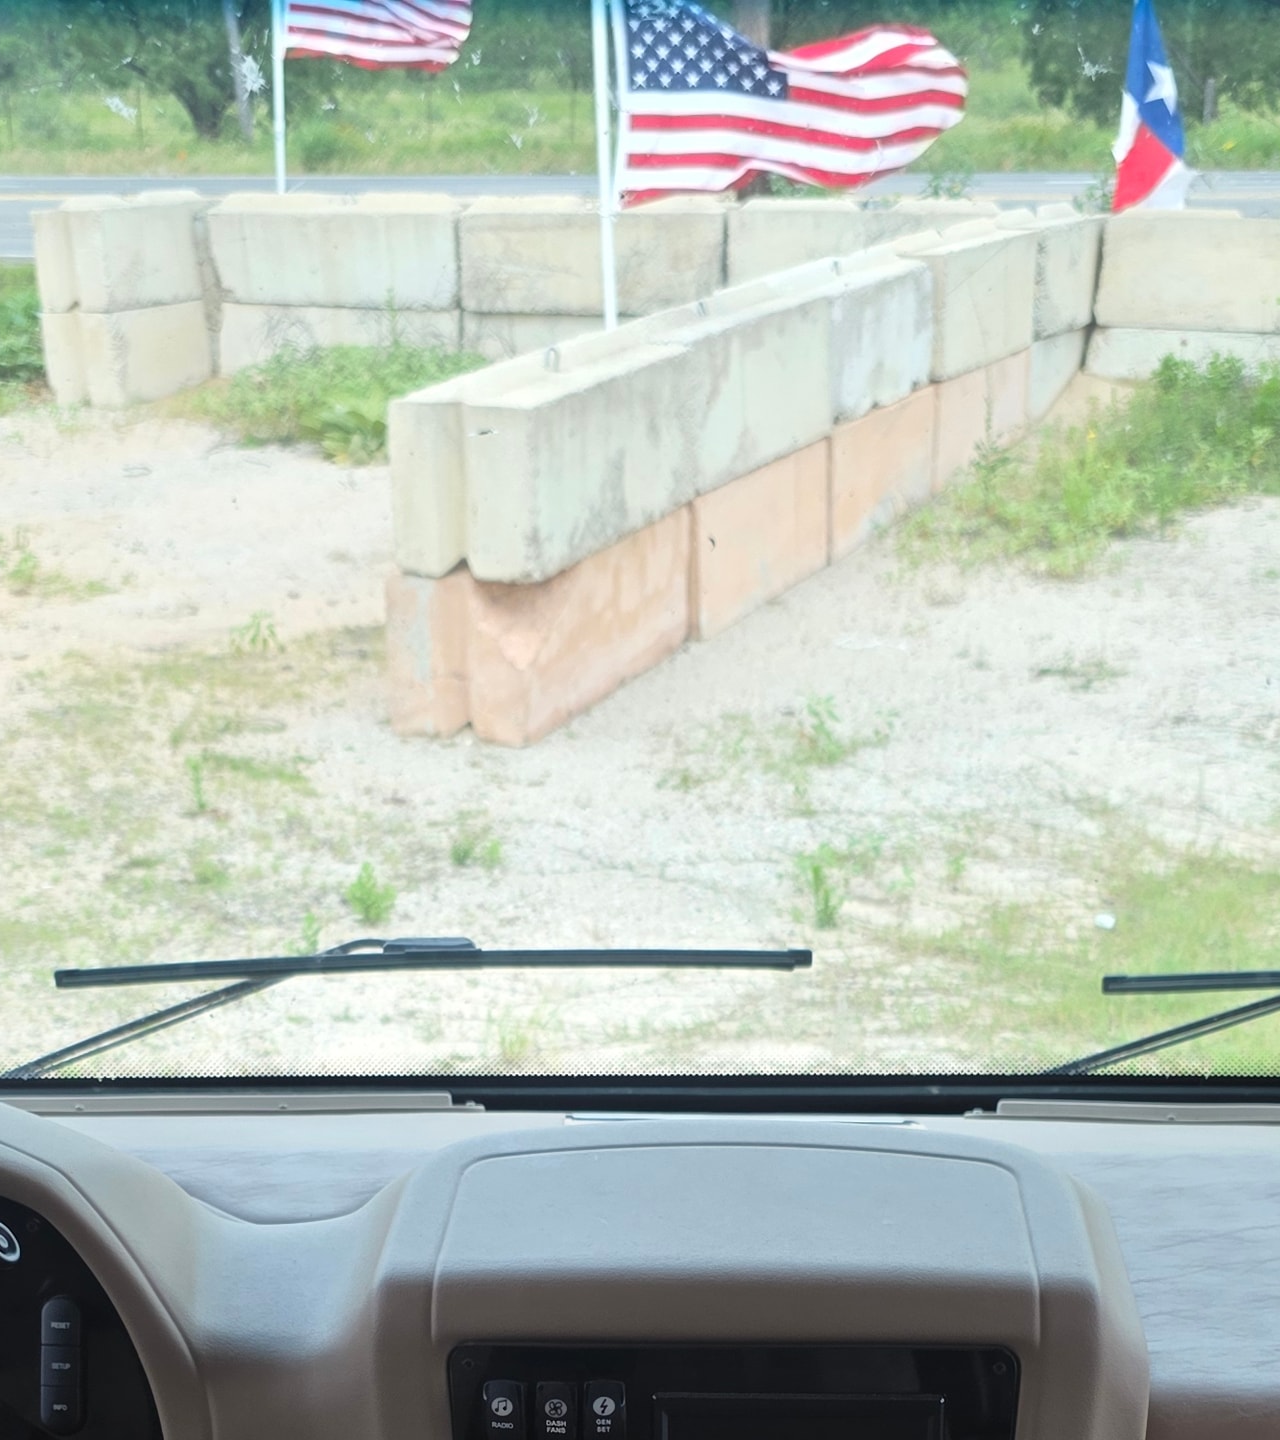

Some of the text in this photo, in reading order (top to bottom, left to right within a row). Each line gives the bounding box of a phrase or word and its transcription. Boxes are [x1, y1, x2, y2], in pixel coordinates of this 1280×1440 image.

[491, 1421, 514, 1430] RADIO
[545, 1419, 567, 1427] DASH
[596, 1418, 612, 1426] GEN
[546, 1427, 567, 1435] FANS
